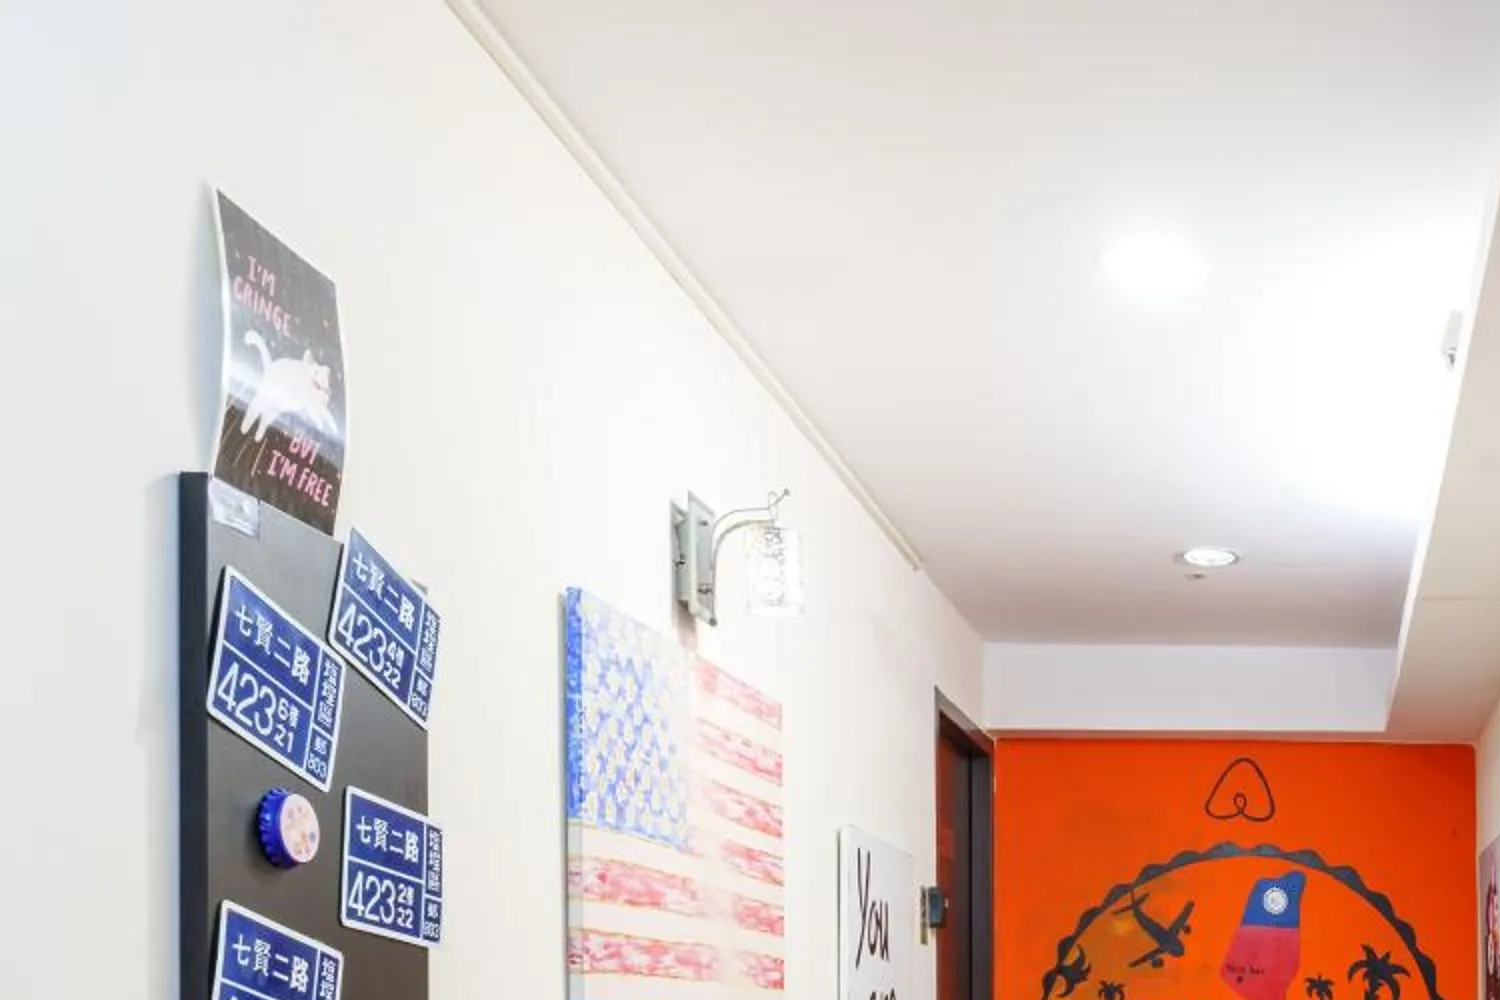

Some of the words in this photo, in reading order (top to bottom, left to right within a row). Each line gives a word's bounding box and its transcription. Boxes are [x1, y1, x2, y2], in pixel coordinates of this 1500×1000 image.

[248, 255, 277, 297] I'M
[267, 451, 296, 487] I'M
[298, 468, 333, 508] FREE
[352, 551, 415, 632] 七賢二路
[235, 603, 311, 686] 七賢二路
[337, 602, 387, 673] 423
[217, 661, 277, 736] 423
[356, 815, 419, 864] 七賢二路
[348, 870, 397, 925] 423
[855, 847, 890, 969] You
[232, 933, 310, 993] 七賢二路
